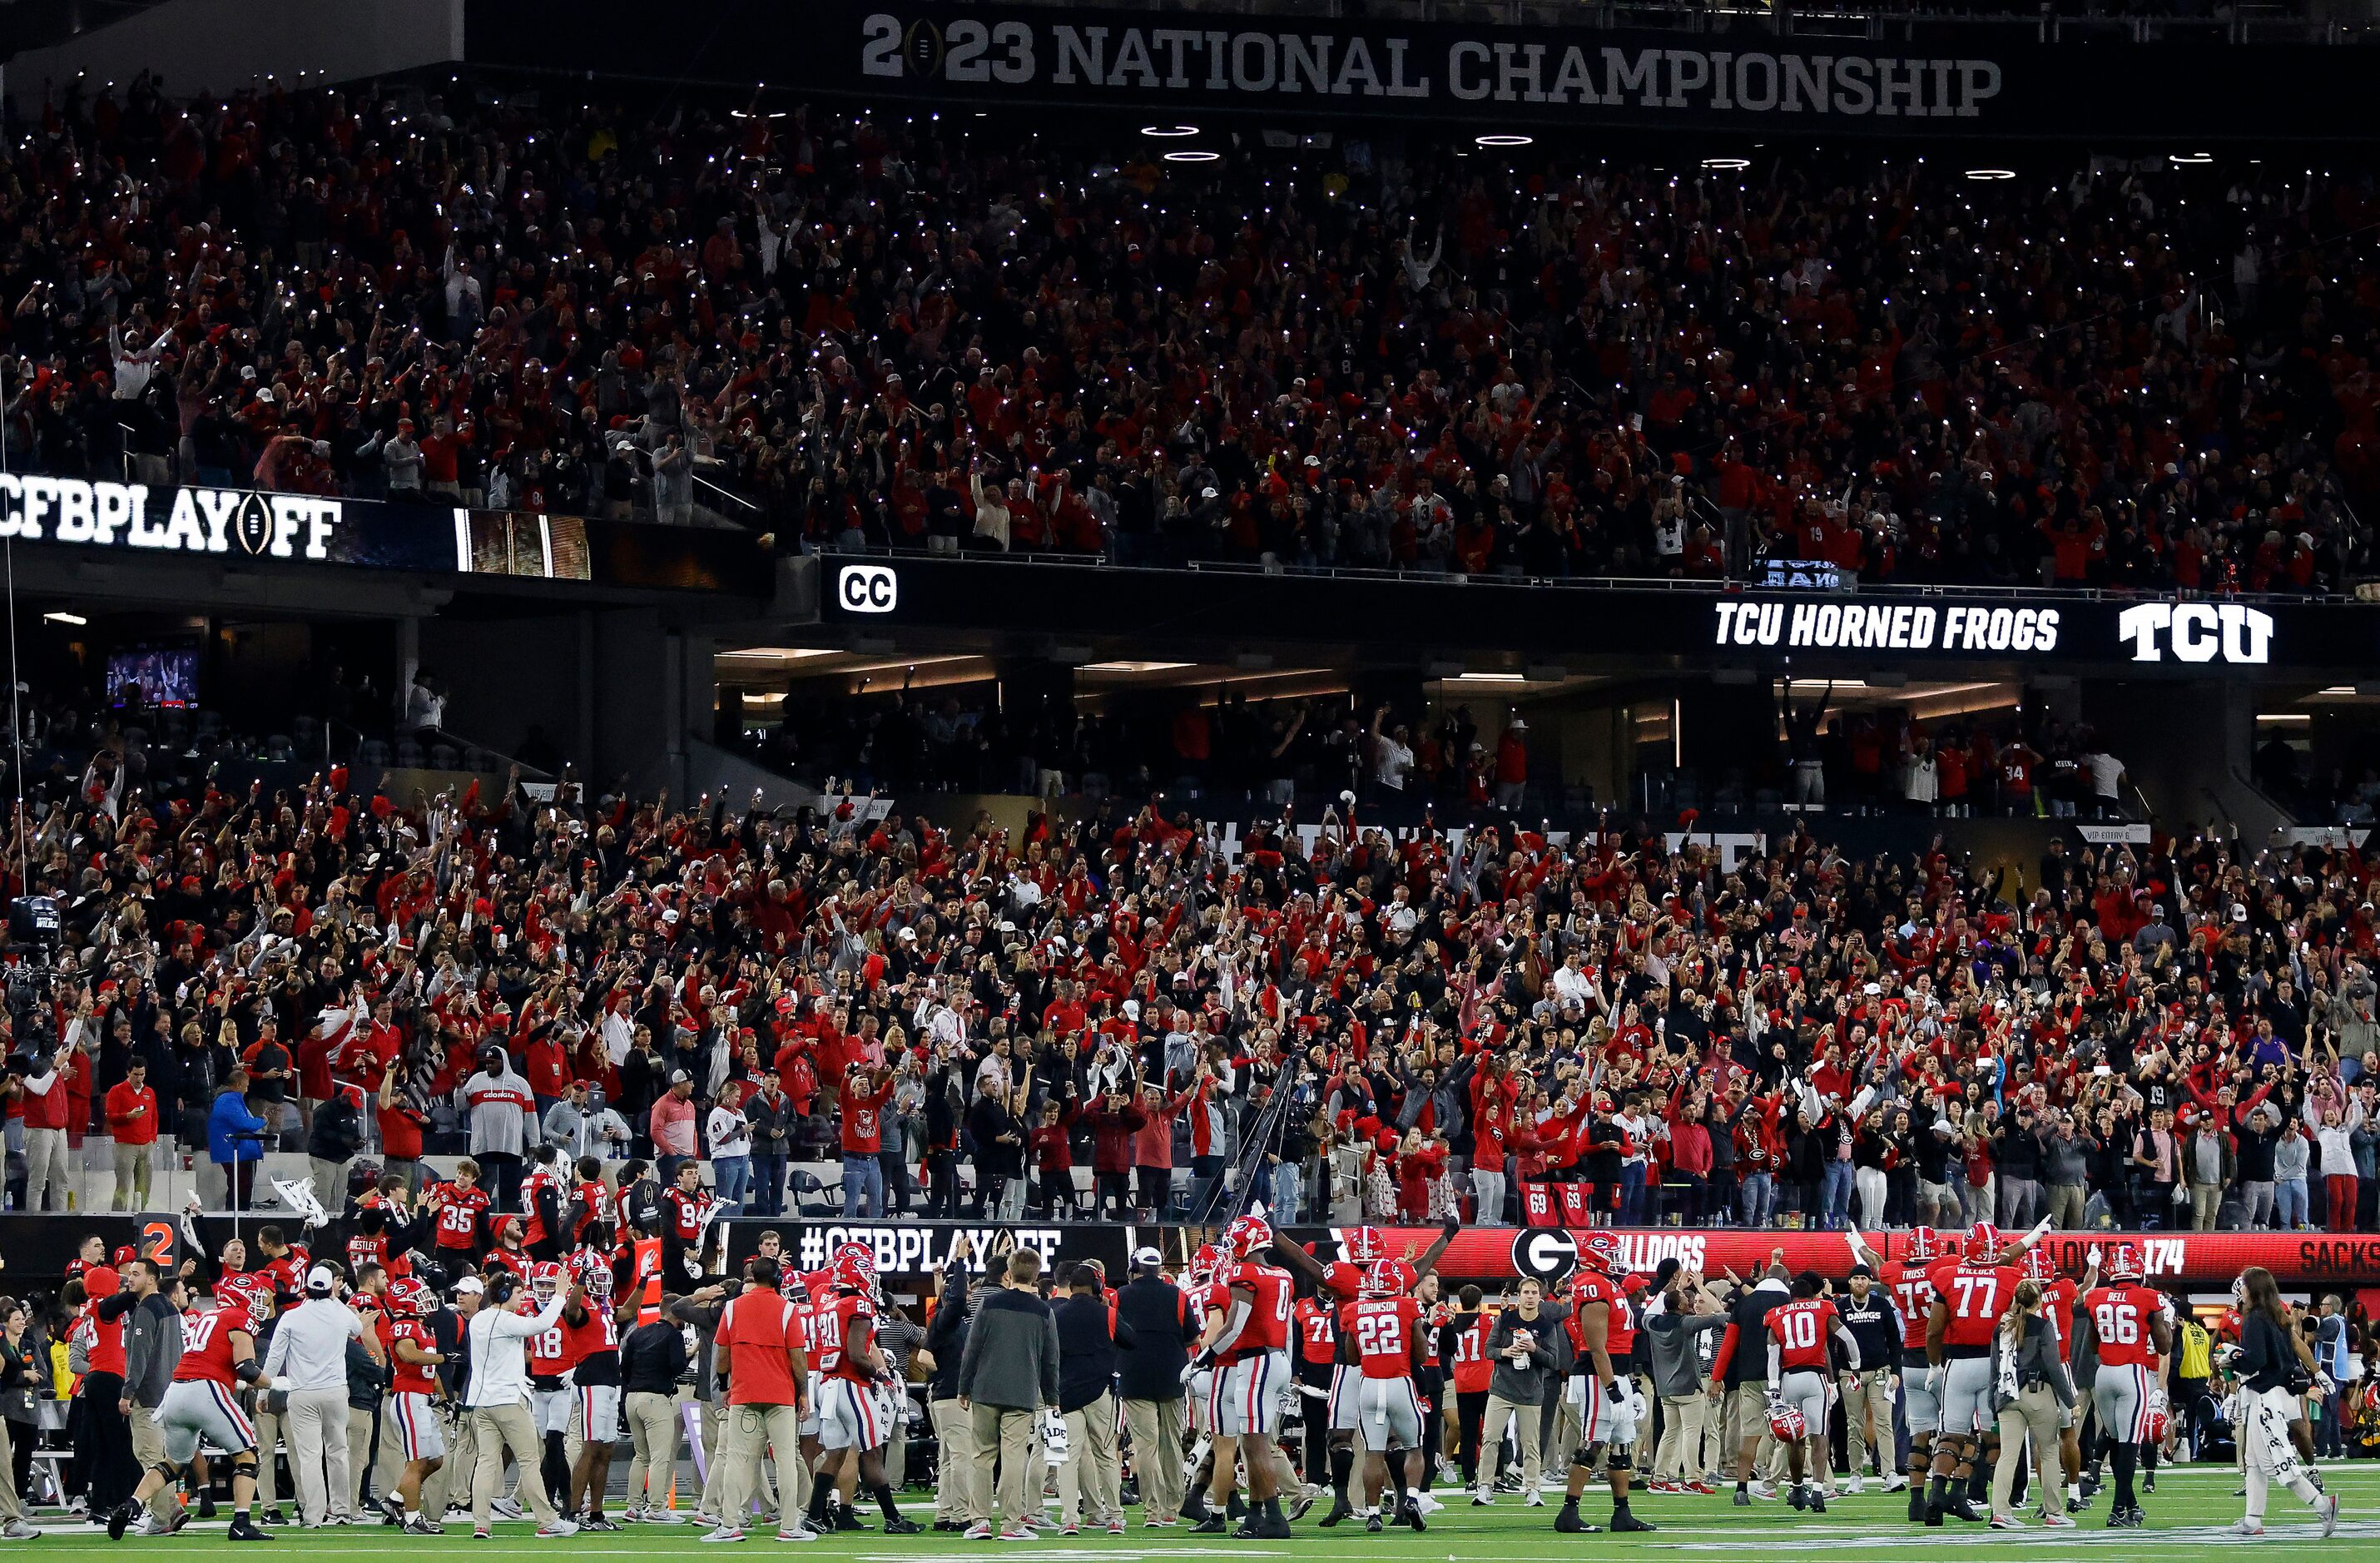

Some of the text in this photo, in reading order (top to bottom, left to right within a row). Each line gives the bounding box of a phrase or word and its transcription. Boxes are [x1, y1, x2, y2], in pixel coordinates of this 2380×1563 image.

[1052, 25, 1429, 97] NATIONAL
[1449, 41, 2001, 117] CHAMPIONSHIP
[845, 573, 890, 607] CC
[1715, 603, 2060, 651] TCU HORNED FROGS
[2119, 603, 2273, 664] TCU
[2006, 765, 2024, 781] 34
[2150, 1085, 2164, 1104] 19
[542, 1178, 554, 1187] 48
[572, 1191, 584, 1201] 39
[1530, 1193, 1547, 1214] 69
[1567, 1191, 1581, 1208] 69
[443, 1205, 475, 1233] 35
[682, 1203, 705, 1228] 94
[143, 1222, 173, 1266] 2
[118, 1251, 125, 1261] 7
[1510, 1229, 1579, 1279] G
[2142, 1238, 2185, 1275] 174
[2300, 1240, 2380, 1274] SACKS
[1233, 1265, 1242, 1278] 0
[1322, 1263, 1334, 1280] 59
[1902, 1268, 1926, 1280] TRUSS
[1956, 1266, 1996, 1276] WILLOCK
[356, 1295, 372, 1305] 76
[1276, 1278, 1289, 1322] 0
[1580, 1284, 1598, 1298] 70
[1896, 1280, 1936, 1320] 73
[1953, 1277, 1997, 1318] 77
[2041, 1290, 2060, 1302] MITH
[2107, 1292, 2127, 1302] BELL
[856, 1299, 871, 1314] 20
[1357, 1301, 1398, 1315] ROBINSON
[1775, 1301, 1821, 1316] K. JACKSON
[1847, 1311, 1881, 1322] DAWGS
[2095, 1303, 2139, 1344] 86
[245, 1317, 259, 1336] 50
[393, 1323, 413, 1337] 87
[1309, 1316, 1335, 1343] 71
[1356, 1314, 1401, 1356] 22
[1782, 1312, 1817, 1349] 10
[533, 1327, 563, 1358] 18
